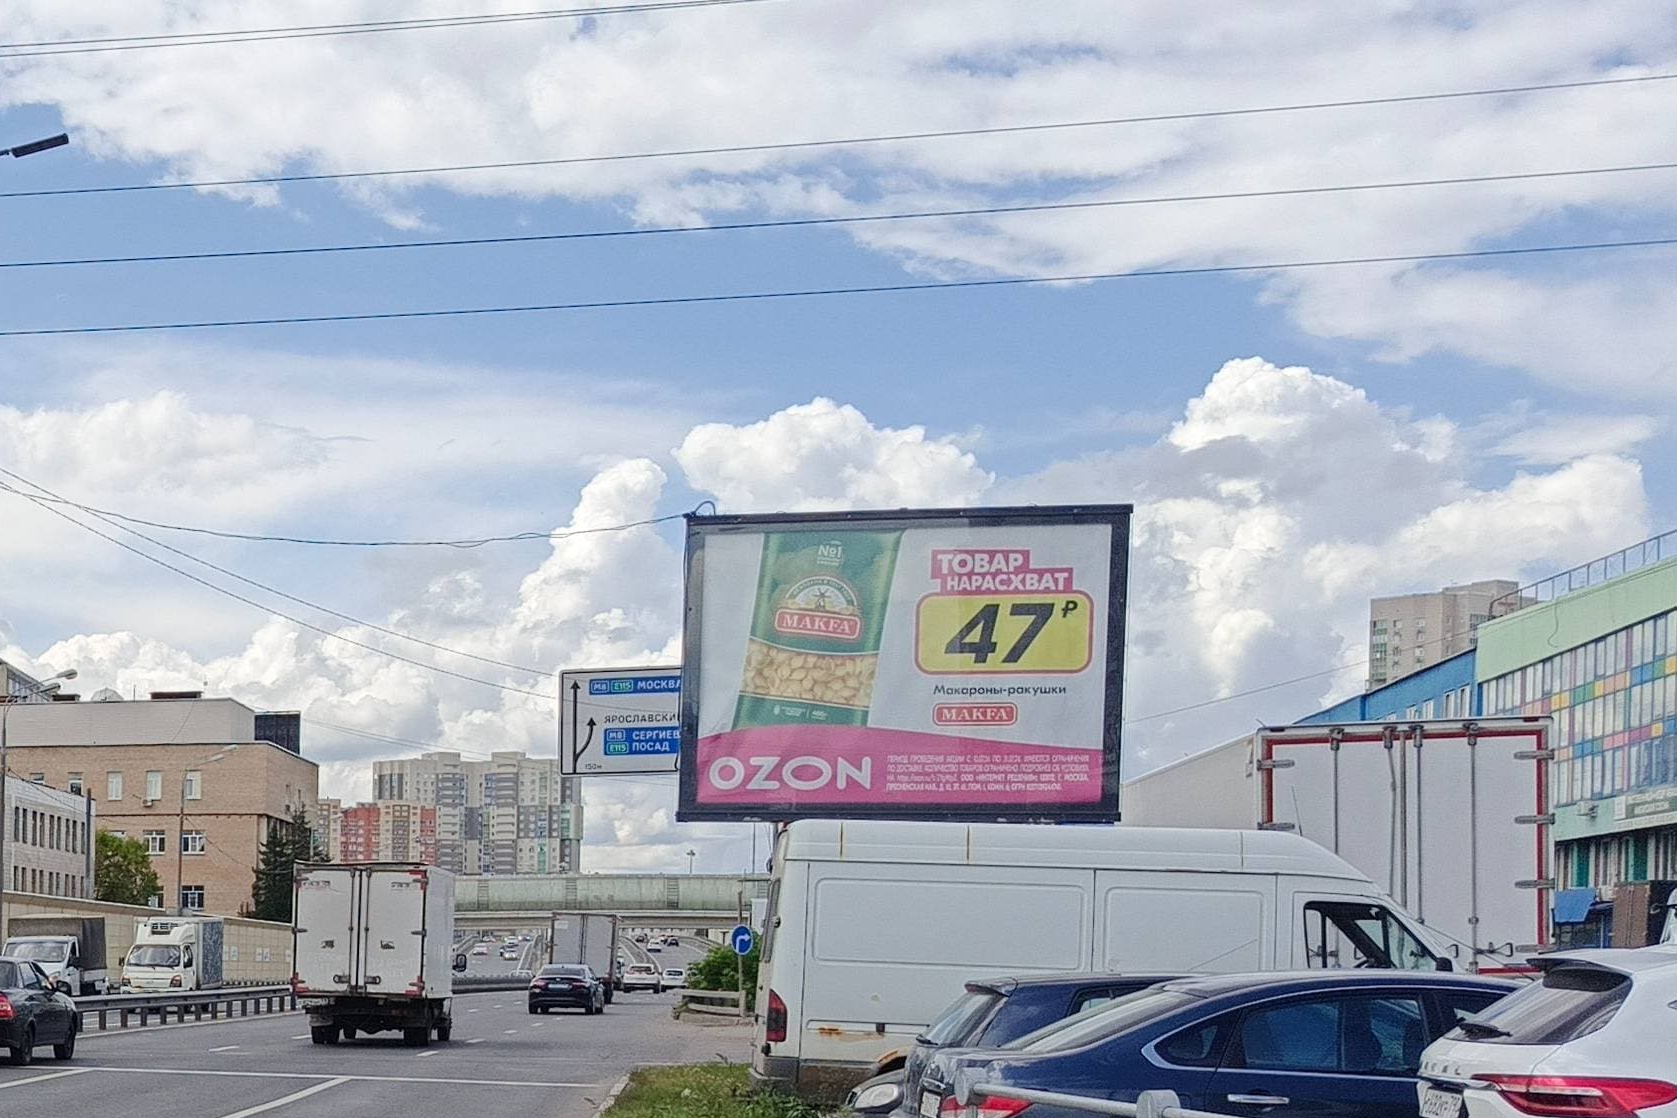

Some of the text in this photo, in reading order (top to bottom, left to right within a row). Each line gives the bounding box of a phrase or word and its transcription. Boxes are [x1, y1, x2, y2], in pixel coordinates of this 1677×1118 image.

[937, 553, 1023, 574] ТОВАР
[946, 572, 1069, 592] НАРАСХВАТ
[781, 613, 853, 635] MAKFA
[944, 602, 1056, 664] 47
[933, 685, 1067, 697] Макароны-ракушки
[603, 713, 680, 724] ЯРОСЛАВСКИ
[942, 708, 1008, 721] MAKFA
[632, 729, 681, 740] СЕРГИЕВ
[632, 741, 670, 752] ПОСАД
[709, 755, 872, 791] OZON
